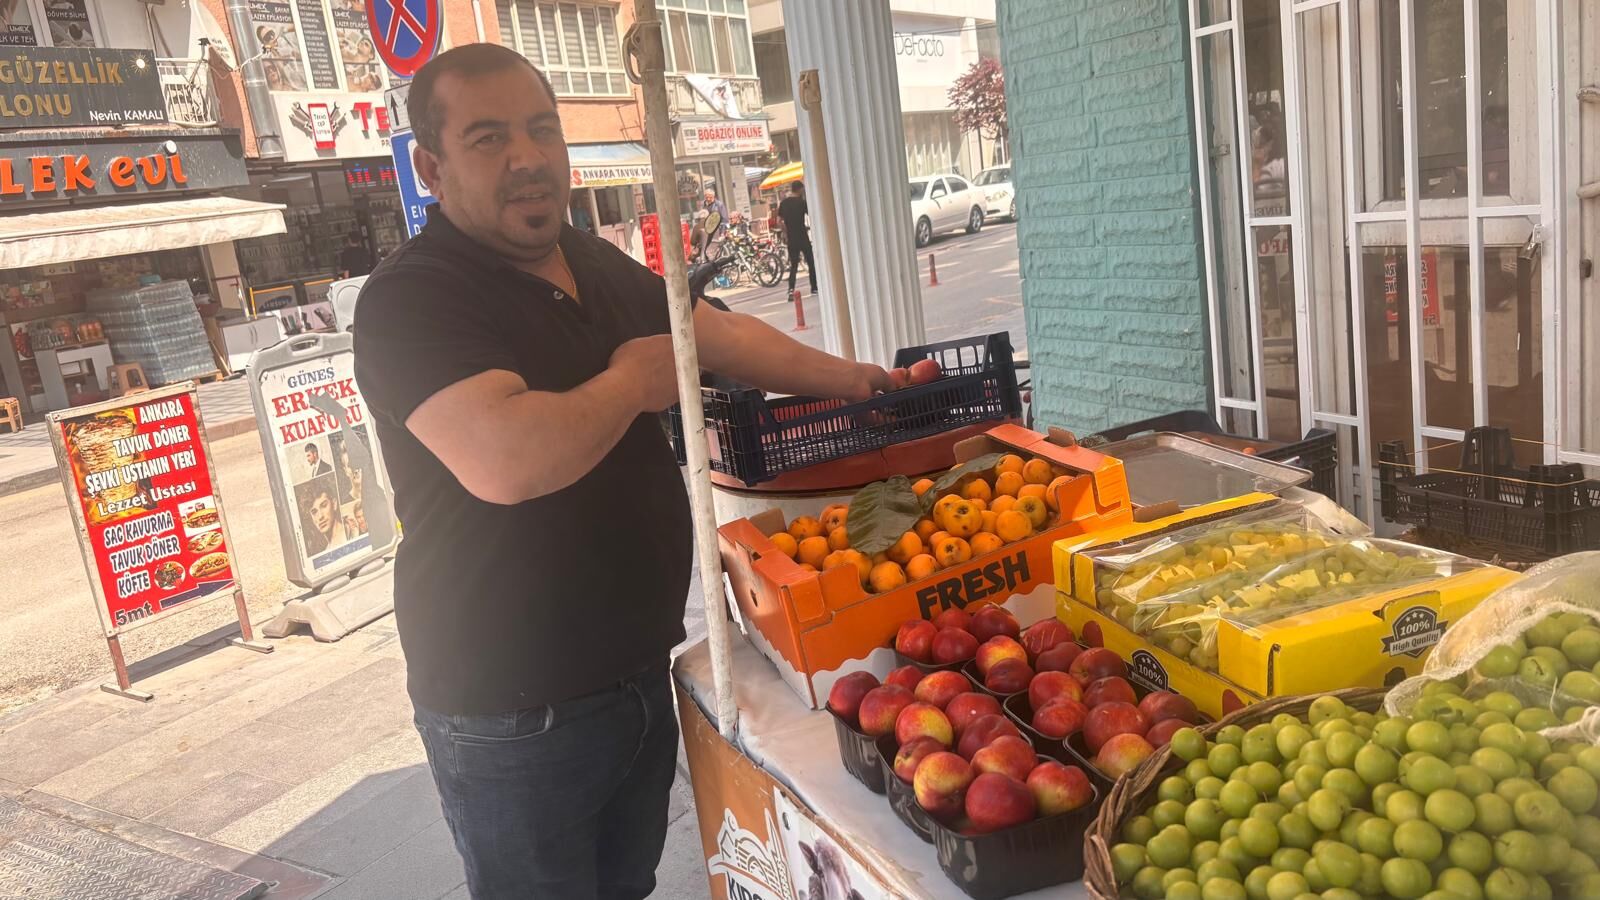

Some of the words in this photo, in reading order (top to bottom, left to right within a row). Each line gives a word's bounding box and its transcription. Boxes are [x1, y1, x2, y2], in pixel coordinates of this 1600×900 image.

[0, 56, 124, 85] GÜZELLİK
[89, 110, 122, 121] Nevin
[124, 110, 164, 121] KAMALI
[288, 366, 335, 388] GÜNEŞ
[140, 399, 184, 424] ANKARA
[113, 435, 152, 458] TAVUK
[153, 425, 191, 448] DÖNER
[85, 464, 121, 498] ŞEVKİ
[122, 456, 170, 484] USTANIN
[170, 445, 197, 471] YERİ
[98, 493, 148, 517] Lezzet
[150, 481, 197, 502] Ustası
[104, 527, 124, 548] SAC
[125, 511, 174, 542] KAVURMA
[110, 546, 145, 573] TAVUK
[145, 536, 181, 562] DÖNER
[117, 572, 151, 599] KÖFTE
[915, 550, 1032, 621] FRESH
[115, 602, 153, 627] 5mt
[1399, 619, 1431, 636] 100%
[1391, 640, 1411, 653] High
[1411, 632, 1440, 648] Quality
[1137, 663, 1164, 687] 100%
